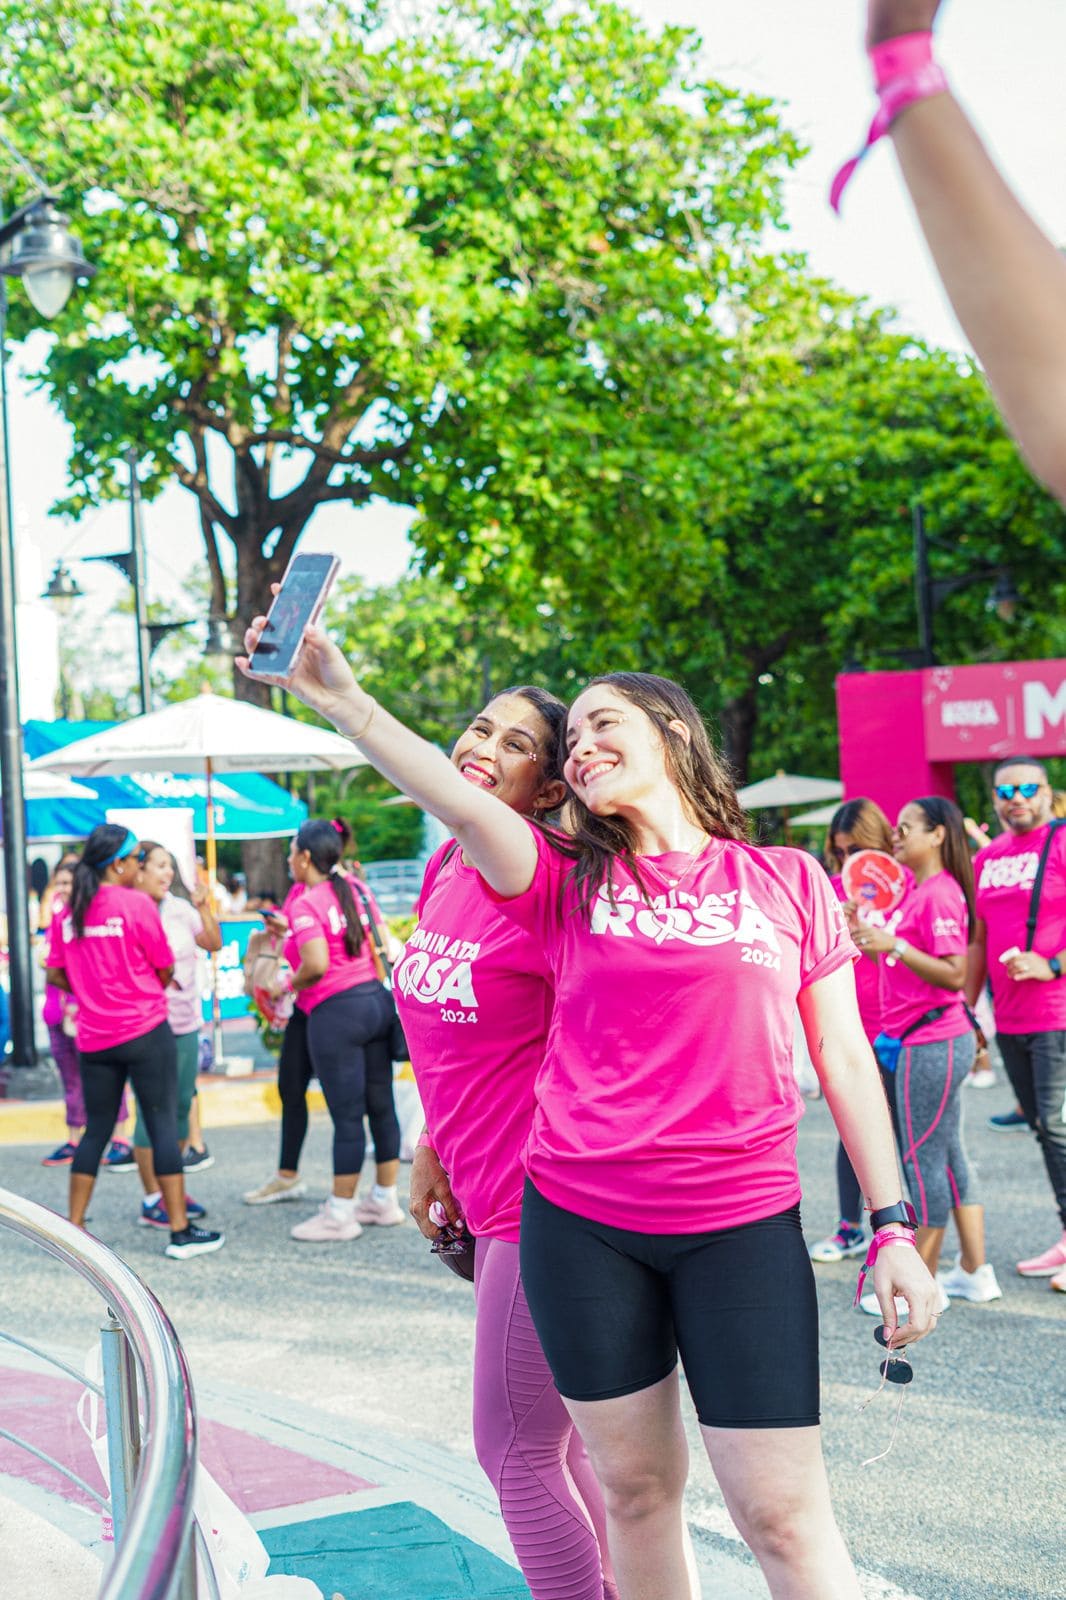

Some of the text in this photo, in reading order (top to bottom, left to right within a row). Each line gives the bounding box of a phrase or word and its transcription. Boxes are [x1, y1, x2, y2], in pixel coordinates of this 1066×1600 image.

[598, 882, 760, 911] CAMINATA
[590, 897, 783, 955] ROSA
[740, 946, 782, 971] 2024
[440, 1008, 479, 1024] 2024
